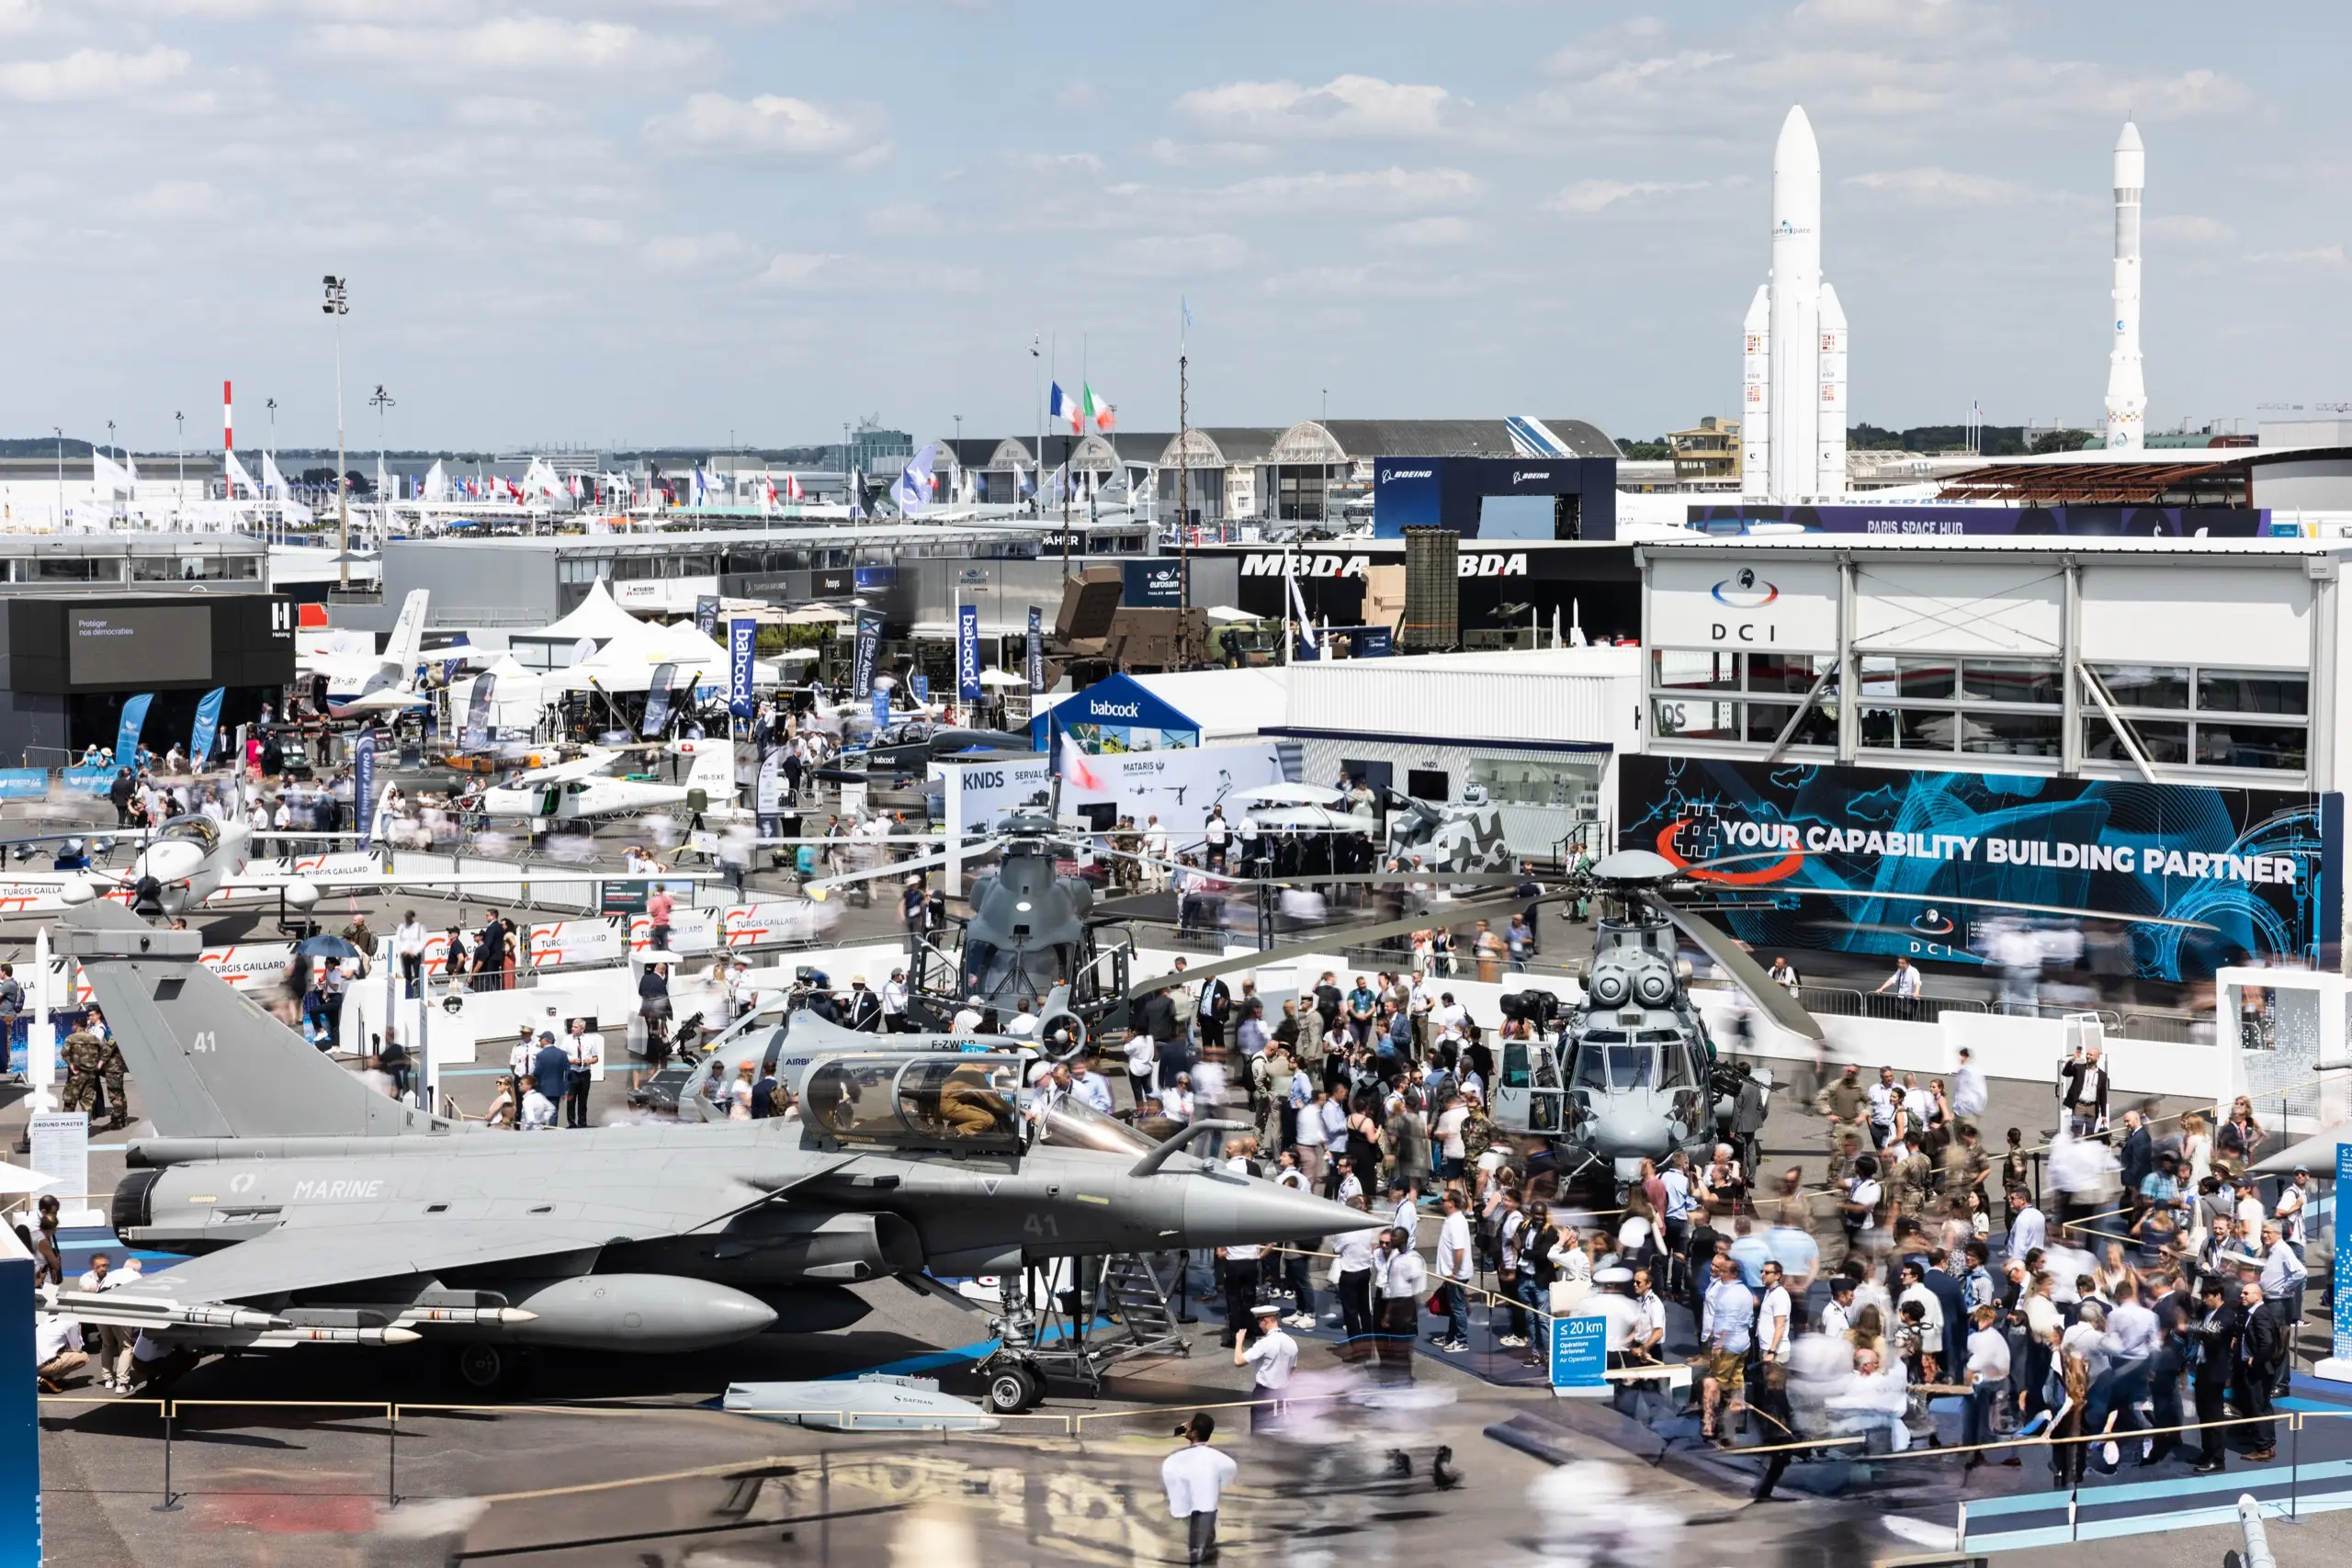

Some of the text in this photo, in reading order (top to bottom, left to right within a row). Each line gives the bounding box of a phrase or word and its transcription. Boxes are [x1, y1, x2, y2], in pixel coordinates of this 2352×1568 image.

[1394, 470, 1432, 479] BOEING
[1868, 520, 1963, 535] PARIS SPACE HUB
[1240, 554, 1370, 577] MBDA
[1458, 553, 1527, 577] BDA
[770, 581, 786, 590] AIRLINES
[825, 578, 840, 589] Ansys
[1149, 580, 1180, 589] eurosam
[79, 619, 107, 628] Protéger
[866, 637, 876, 660] Elixir
[962, 615, 978, 688] babcock
[732, 628, 753, 707] babcock
[333, 675, 358, 687] OK-JRP
[1091, 699, 1140, 718] babcock
[874, 755, 896, 764] babcock
[1422, 761, 1439, 769] KNDS
[362, 752, 372, 779] AERO
[1124, 761, 1154, 772] MATARIS
[1015, 770, 1043, 780] SERVAL
[963, 771, 1004, 791] KNDS
[1806, 826, 1978, 862] CAPABILITY
[1987, 838, 2135, 873] BUILDING
[2143, 848, 2297, 886] PARTNER
[333, 865, 368, 876] GAILLARD
[3, 886, 62, 896] TURGIS GAILLA
[736, 917, 799, 928] TURGIS GAILLARD
[668, 925, 704, 935] GAILLARD
[571, 933, 607, 946] AILLARD
[210, 961, 286, 974] TURGIS GAILLARD
[194, 1031, 217, 1054] 41
[293, 1180, 384, 1200] MARINE
[1023, 1213, 1059, 1237] 41
[1570, 1321, 1584, 1335] 20
[1586, 1320, 1603, 1334] km
[1559, 1340, 1589, 1349] Opérations
[1559, 1348, 1586, 1356] Aériennes
[1567, 1355, 1597, 1363] Operations
[902, 1397, 934, 1406] SAFRAN
